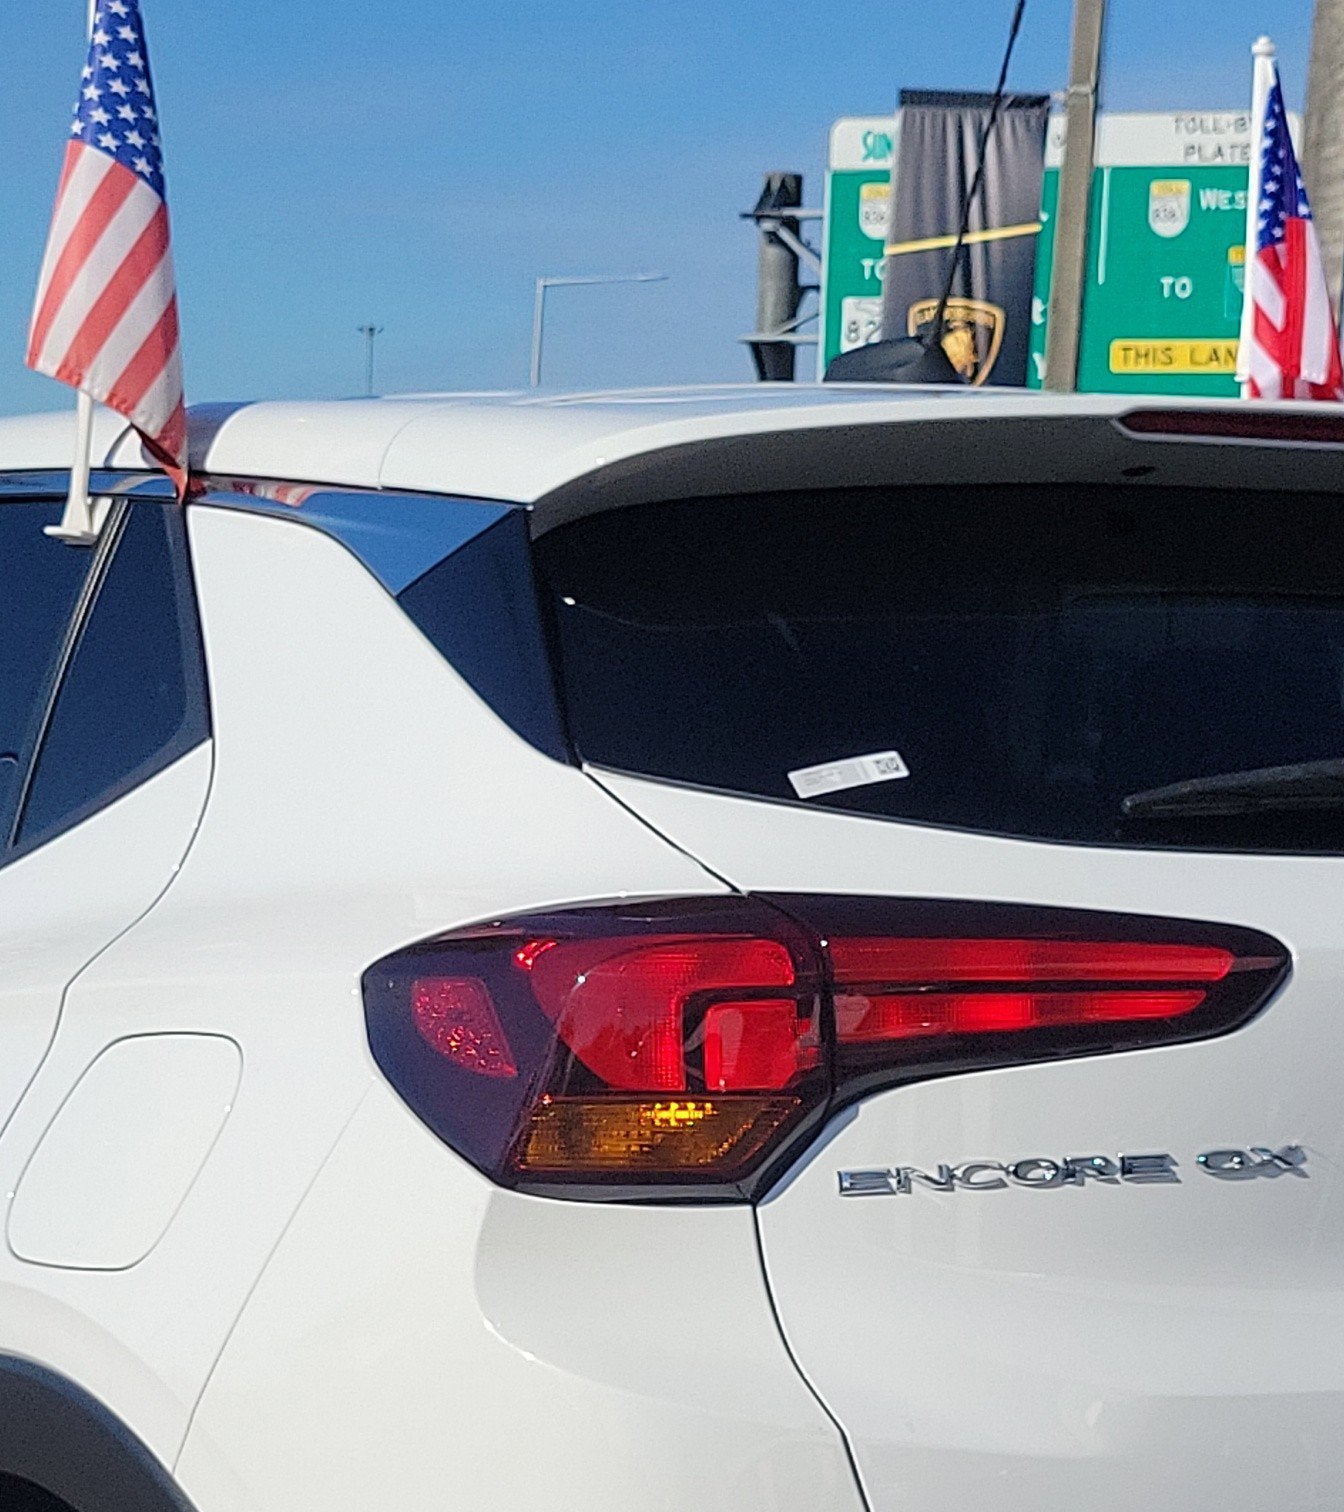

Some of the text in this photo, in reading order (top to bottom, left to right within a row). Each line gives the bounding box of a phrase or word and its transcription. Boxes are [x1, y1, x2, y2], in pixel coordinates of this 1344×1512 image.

[1199, 188, 1248, 210] WES
[1159, 275, 1193, 299] TO
[1121, 346, 1239, 365] THIS LAN
[838, 1145, 1310, 1196] ENCORE GX
